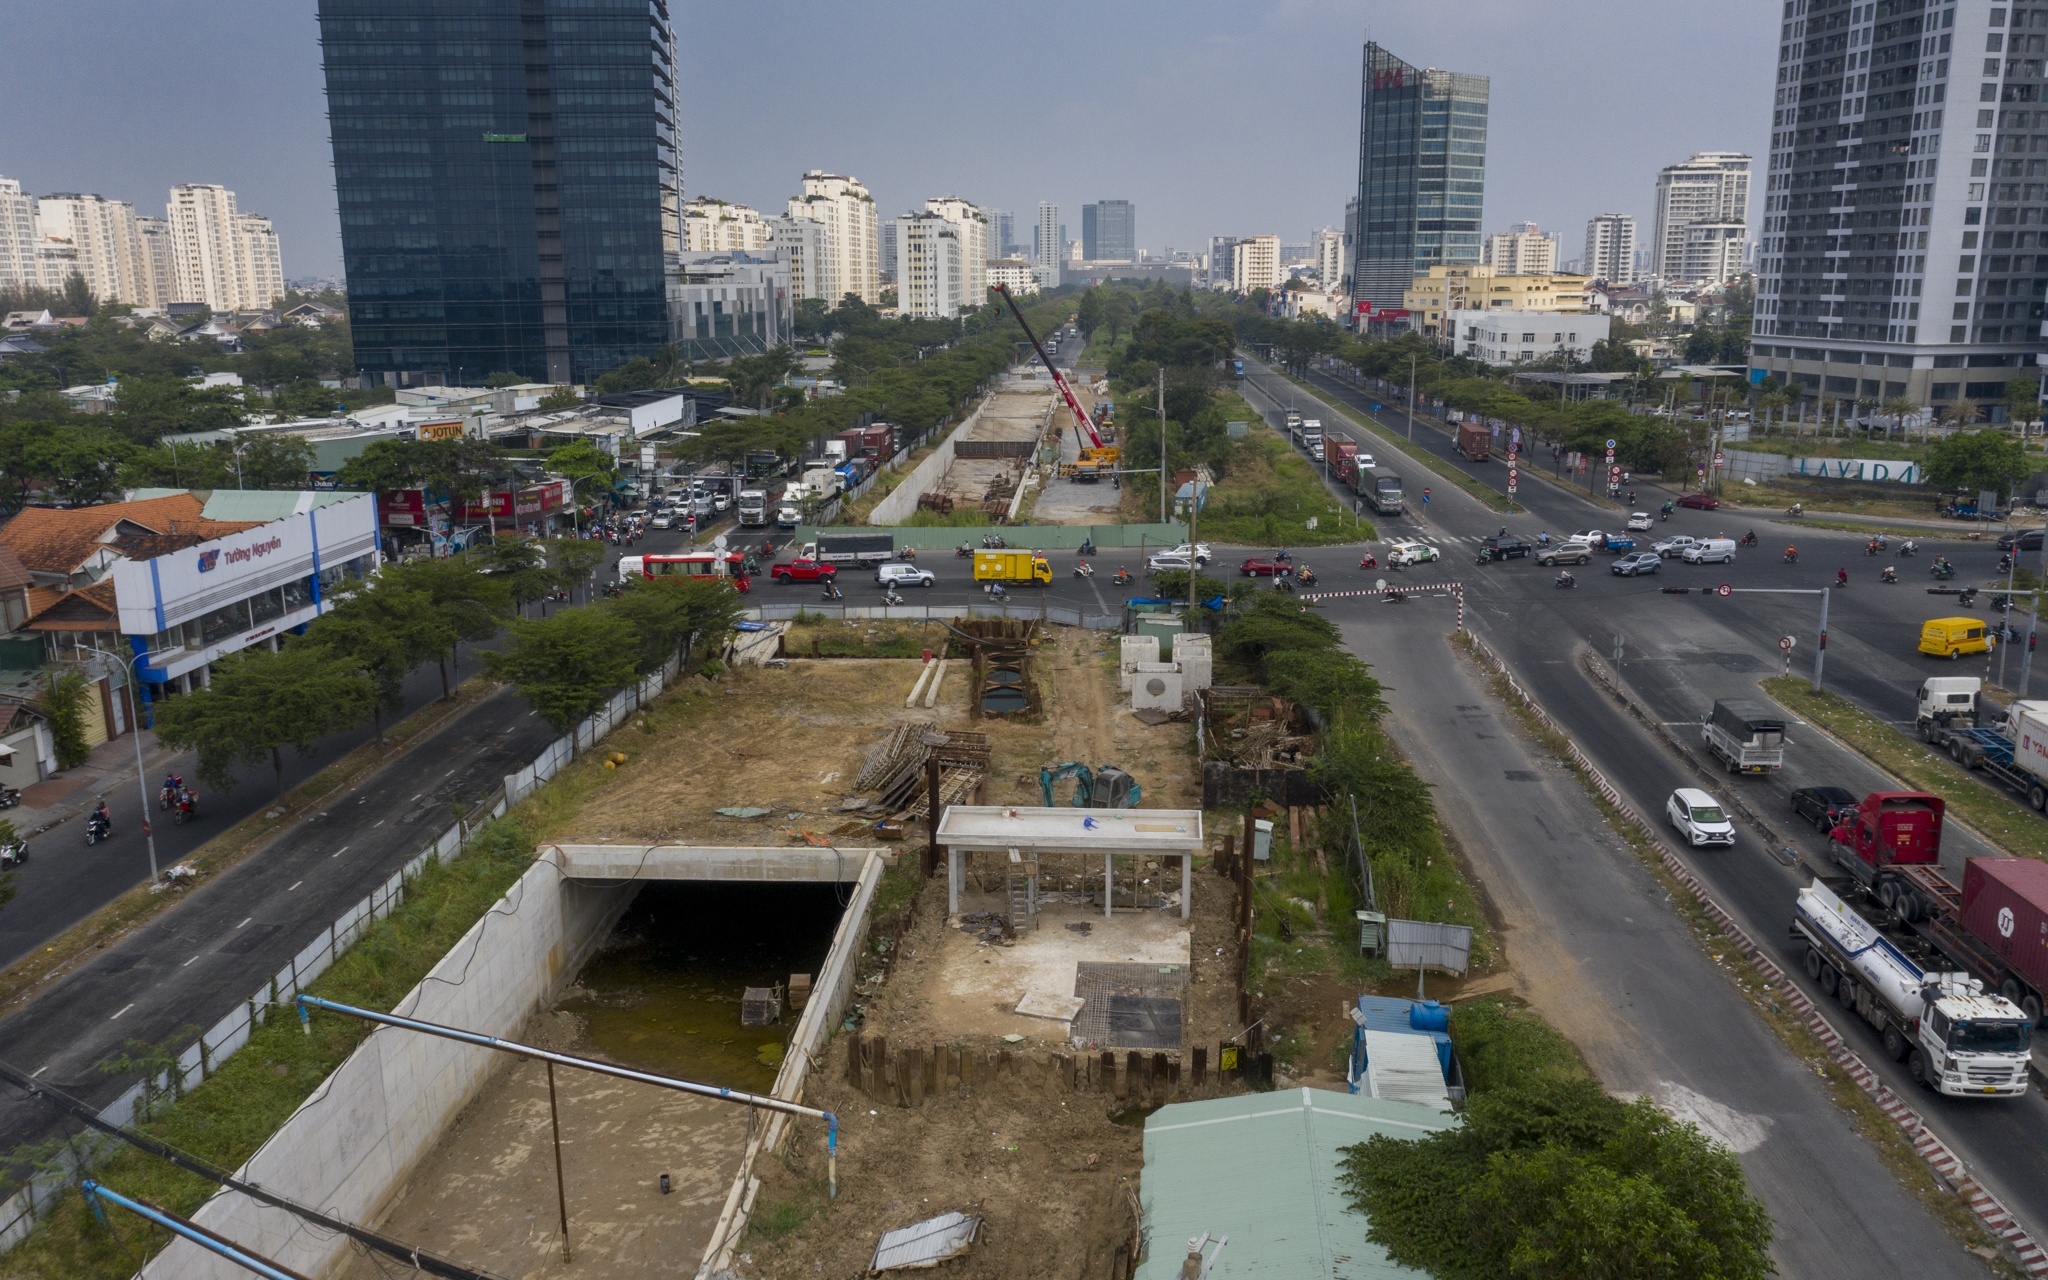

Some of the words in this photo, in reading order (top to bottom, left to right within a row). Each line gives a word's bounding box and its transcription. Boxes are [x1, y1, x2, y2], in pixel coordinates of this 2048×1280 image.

[432, 426, 462, 438] JOTUN
[224, 547, 251, 565] Tường
[252, 535, 281, 558] Nguyên
